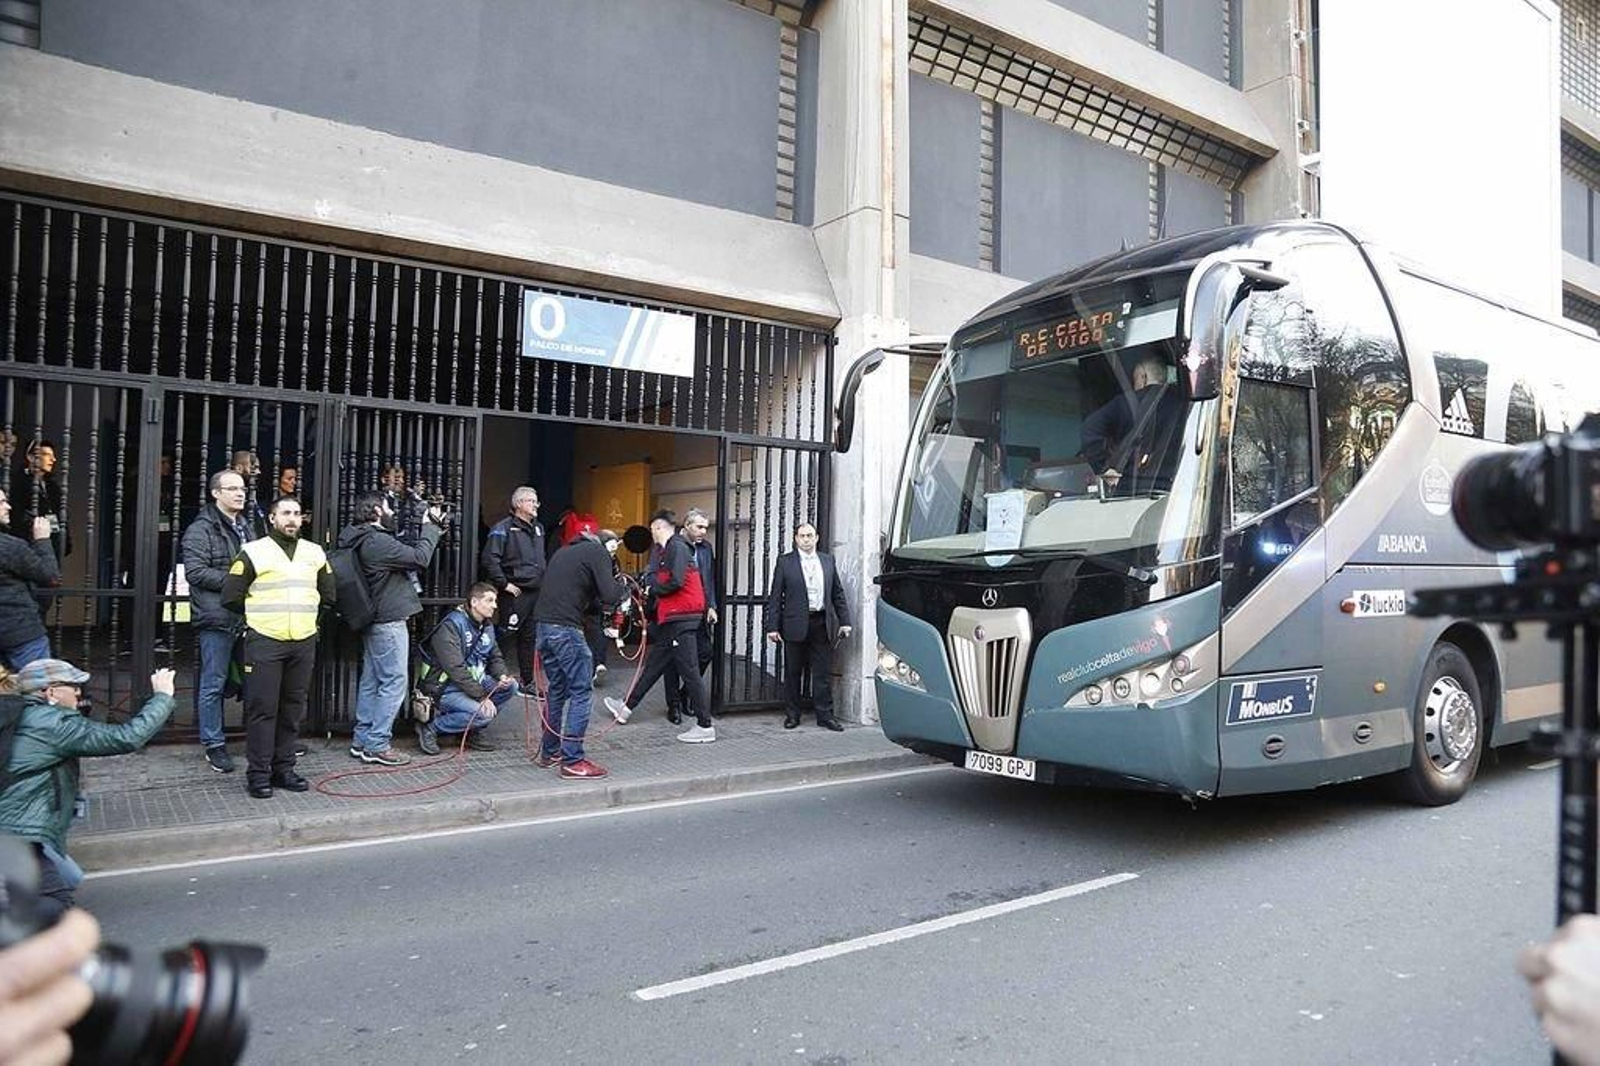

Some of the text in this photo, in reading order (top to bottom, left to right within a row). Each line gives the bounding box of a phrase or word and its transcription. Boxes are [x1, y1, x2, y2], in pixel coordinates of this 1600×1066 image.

[1027, 328, 1103, 358] DE VIGO
[1441, 416, 1475, 435] adidas
[1379, 534, 1427, 553] ABANCA
[1372, 592, 1404, 614] luckia
[971, 753, 1033, 777] 7099 GPJ
